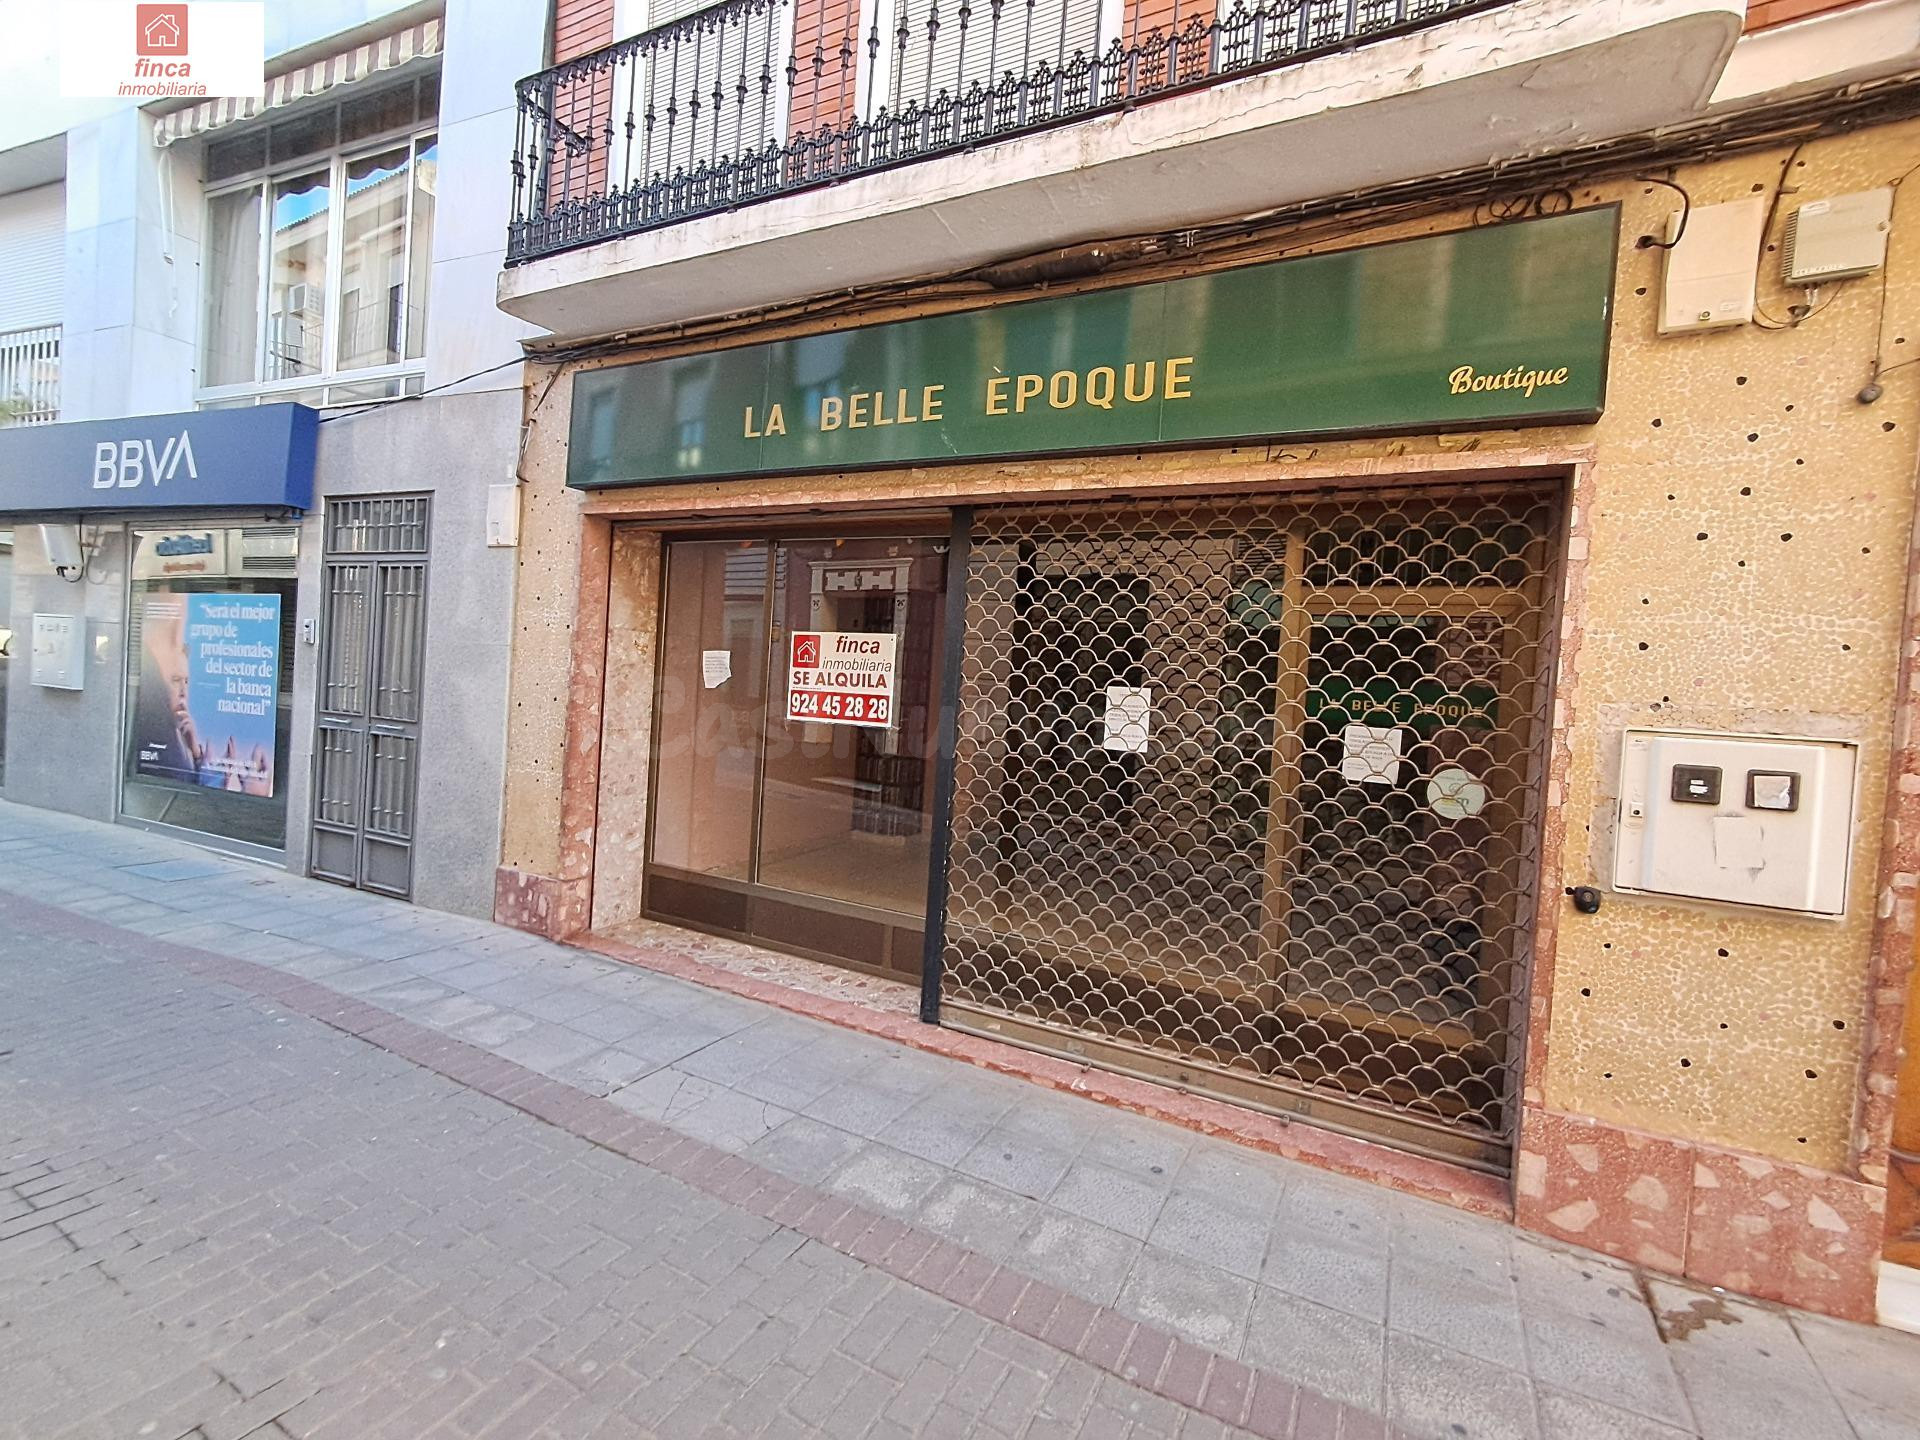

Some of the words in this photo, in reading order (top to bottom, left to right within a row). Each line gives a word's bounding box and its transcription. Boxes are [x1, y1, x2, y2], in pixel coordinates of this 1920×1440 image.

[1448, 365, 1569, 398] Boutique
[743, 404, 787, 438] LA
[820, 384, 945, 432] BELLE
[985, 356, 1194, 416] ÈPOQUE
[93, 429, 198, 489] BBVA
[230, 602, 241, 618] el
[241, 602, 275, 623] mejor
[191, 623, 223, 640] grupo
[223, 621, 238, 638] de
[200, 640, 274, 659] profesionales
[836, 635, 881, 655] finca
[206, 657, 223, 674] del
[223, 660, 257, 677] sector
[258, 660, 273, 677] de
[822, 657, 892, 673] inmobiliaria
[226, 677, 237, 694] la
[238, 678, 272, 697] banca
[793, 671, 810, 686] SE
[814, 672, 888, 689] ALQUILA
[791, 693, 819, 714] 924
[822, 695, 841, 716] 45
[844, 696, 864, 718] 28
[868, 698, 888, 720] 28
